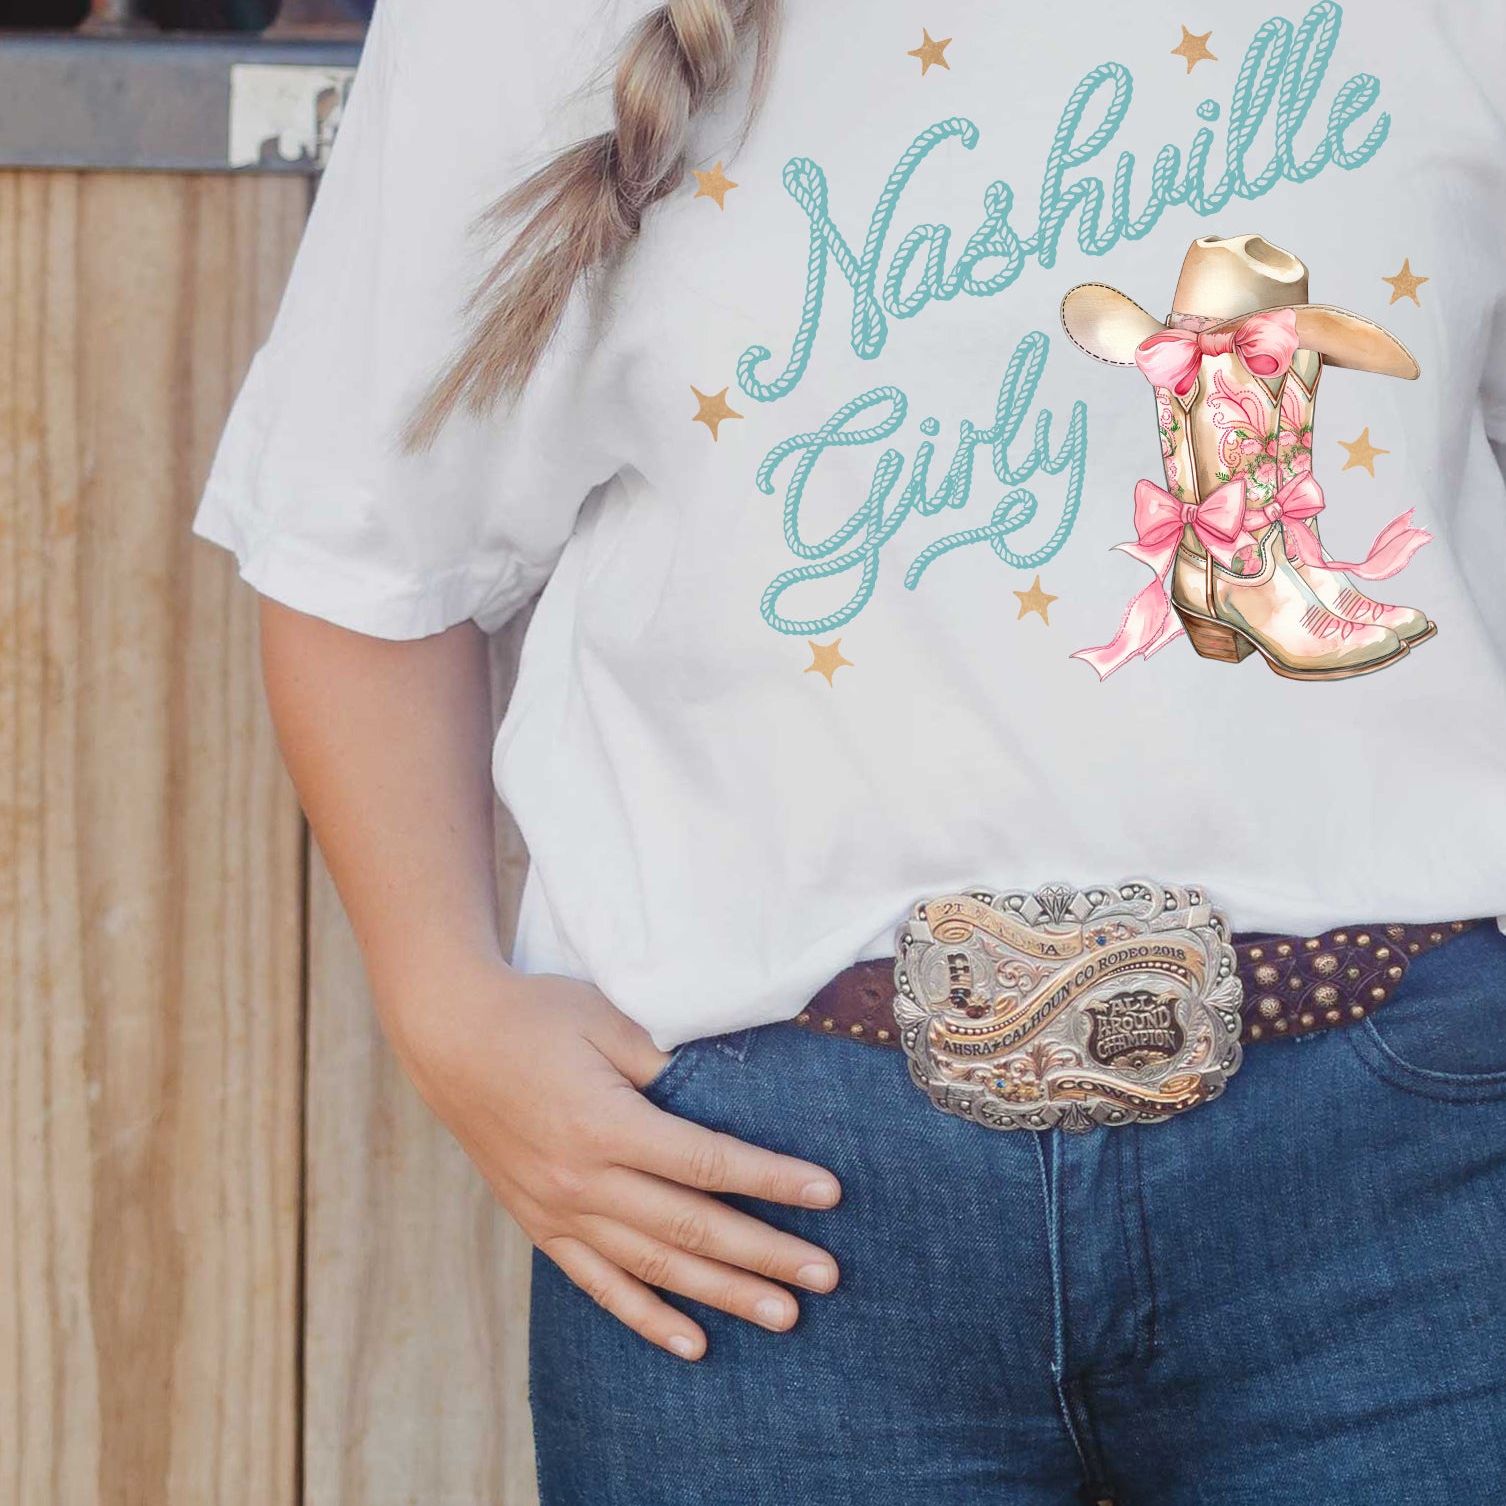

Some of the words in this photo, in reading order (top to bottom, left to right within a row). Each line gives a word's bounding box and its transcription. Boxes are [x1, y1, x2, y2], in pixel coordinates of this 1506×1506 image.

[736, 0, 1391, 403] Nashville
[756, 331, 1088, 636] Girly
[1074, 965, 1095, 987] CO
[1099, 946, 1149, 970] RODEO
[1152, 945, 1187, 961] 2018
[1096, 1005, 1172, 1040] AROUND
[1109, 995, 1156, 1017] ALL
[1097, 1029, 1177, 1059] CHAMPION
